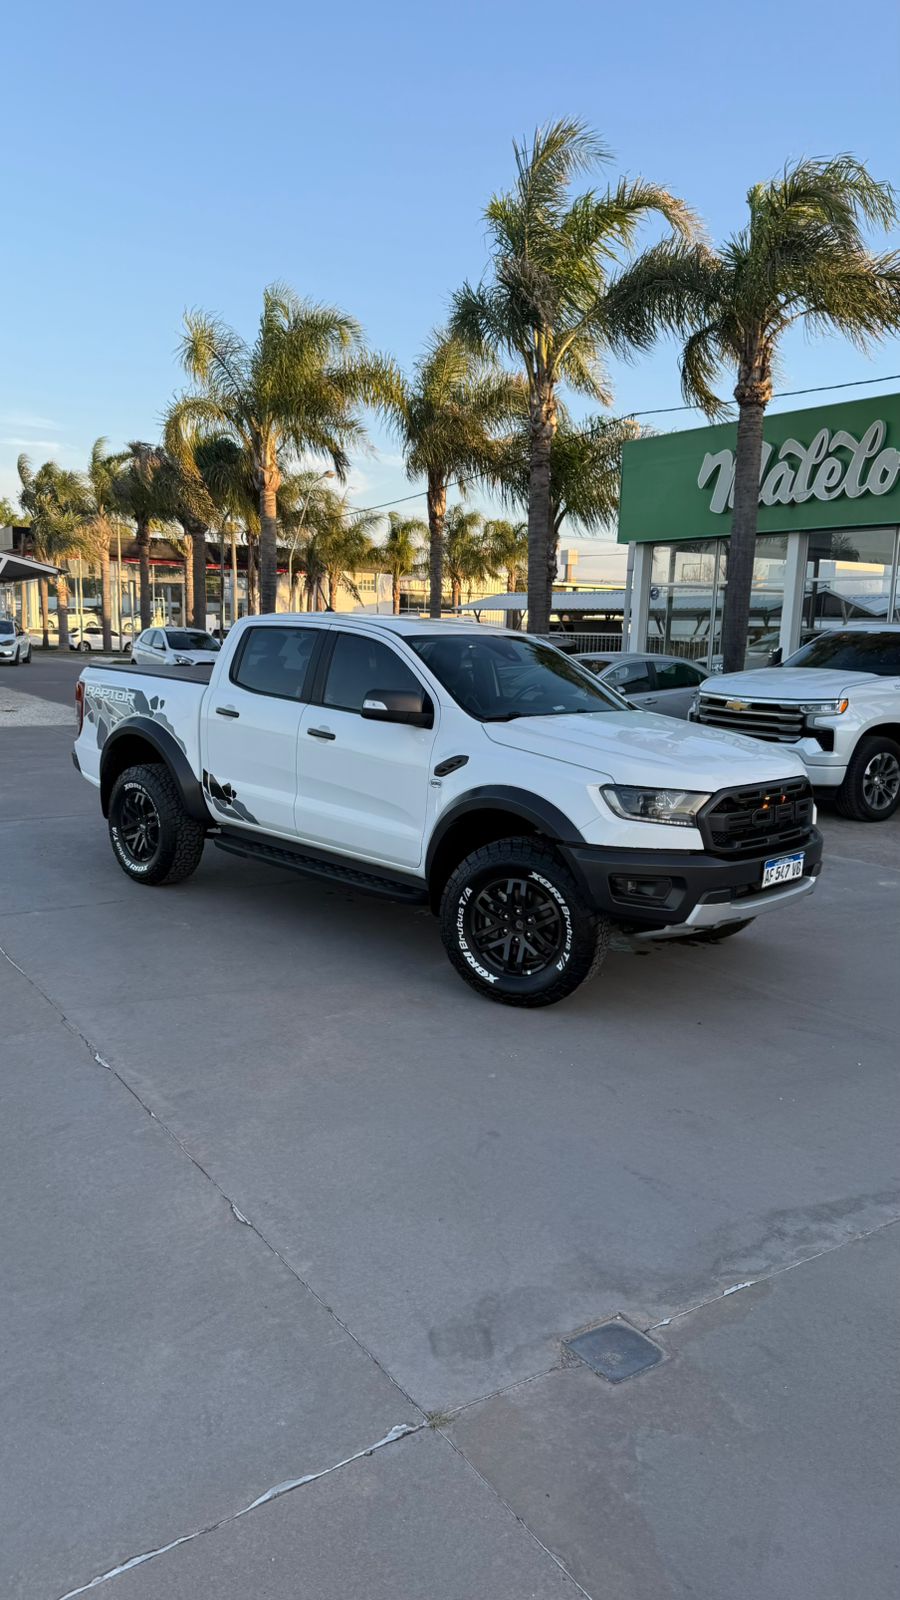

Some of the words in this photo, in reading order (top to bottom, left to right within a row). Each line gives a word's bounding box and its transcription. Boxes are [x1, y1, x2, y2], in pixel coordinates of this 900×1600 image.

[86, 685, 136, 704] RAPTOR
[458, 886, 473, 906] T/A
[528, 871, 565, 904] XBRI
[456, 906, 469, 950] Brutus
[561, 905, 573, 951] Brutus
[462, 951, 499, 983] XBRI
[555, 951, 571, 972] T/A
